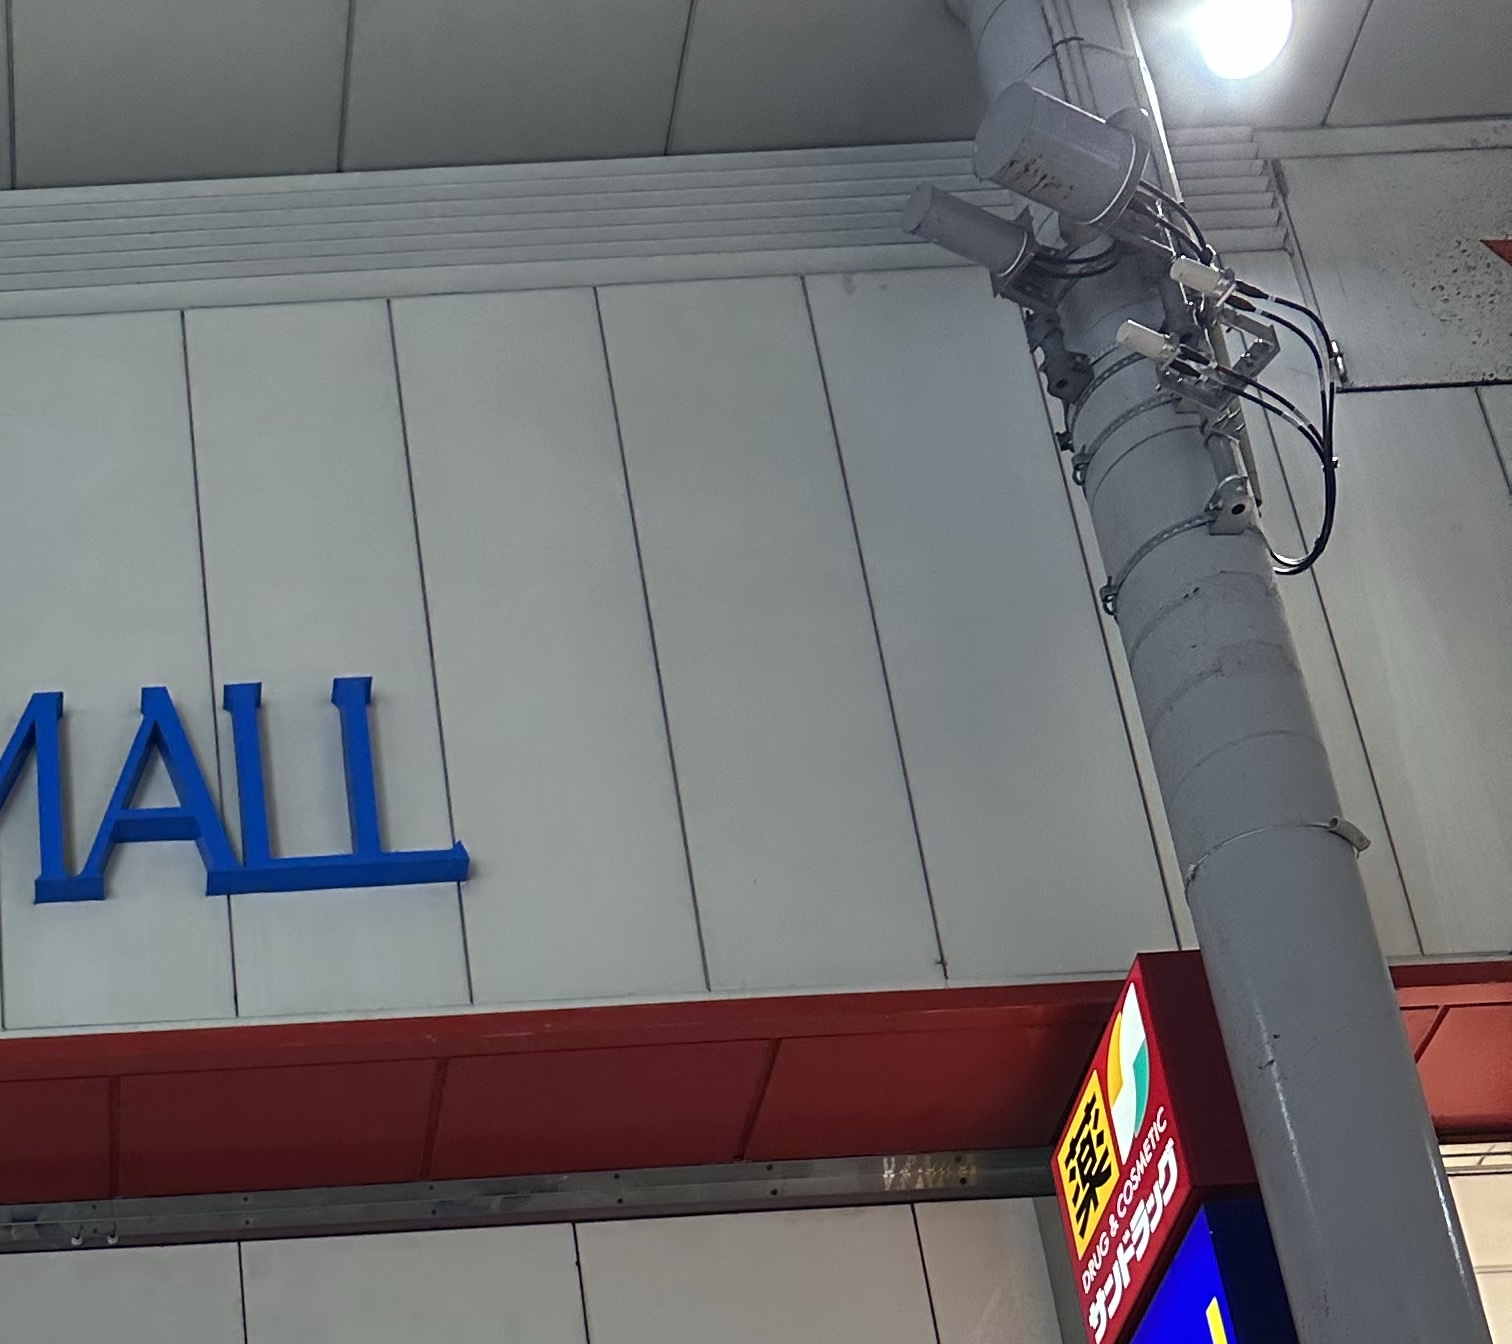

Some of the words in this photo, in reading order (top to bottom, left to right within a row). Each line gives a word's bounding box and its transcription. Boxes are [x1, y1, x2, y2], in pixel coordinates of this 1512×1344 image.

[1065, 1092, 1111, 1239] 薬
[1082, 1232, 1109, 1294] DRUG
[1109, 1213, 1120, 1236] &
[1117, 1106, 1167, 1222] COSMETIC
[1089, 1138, 1178, 1344] サンドラッグ
